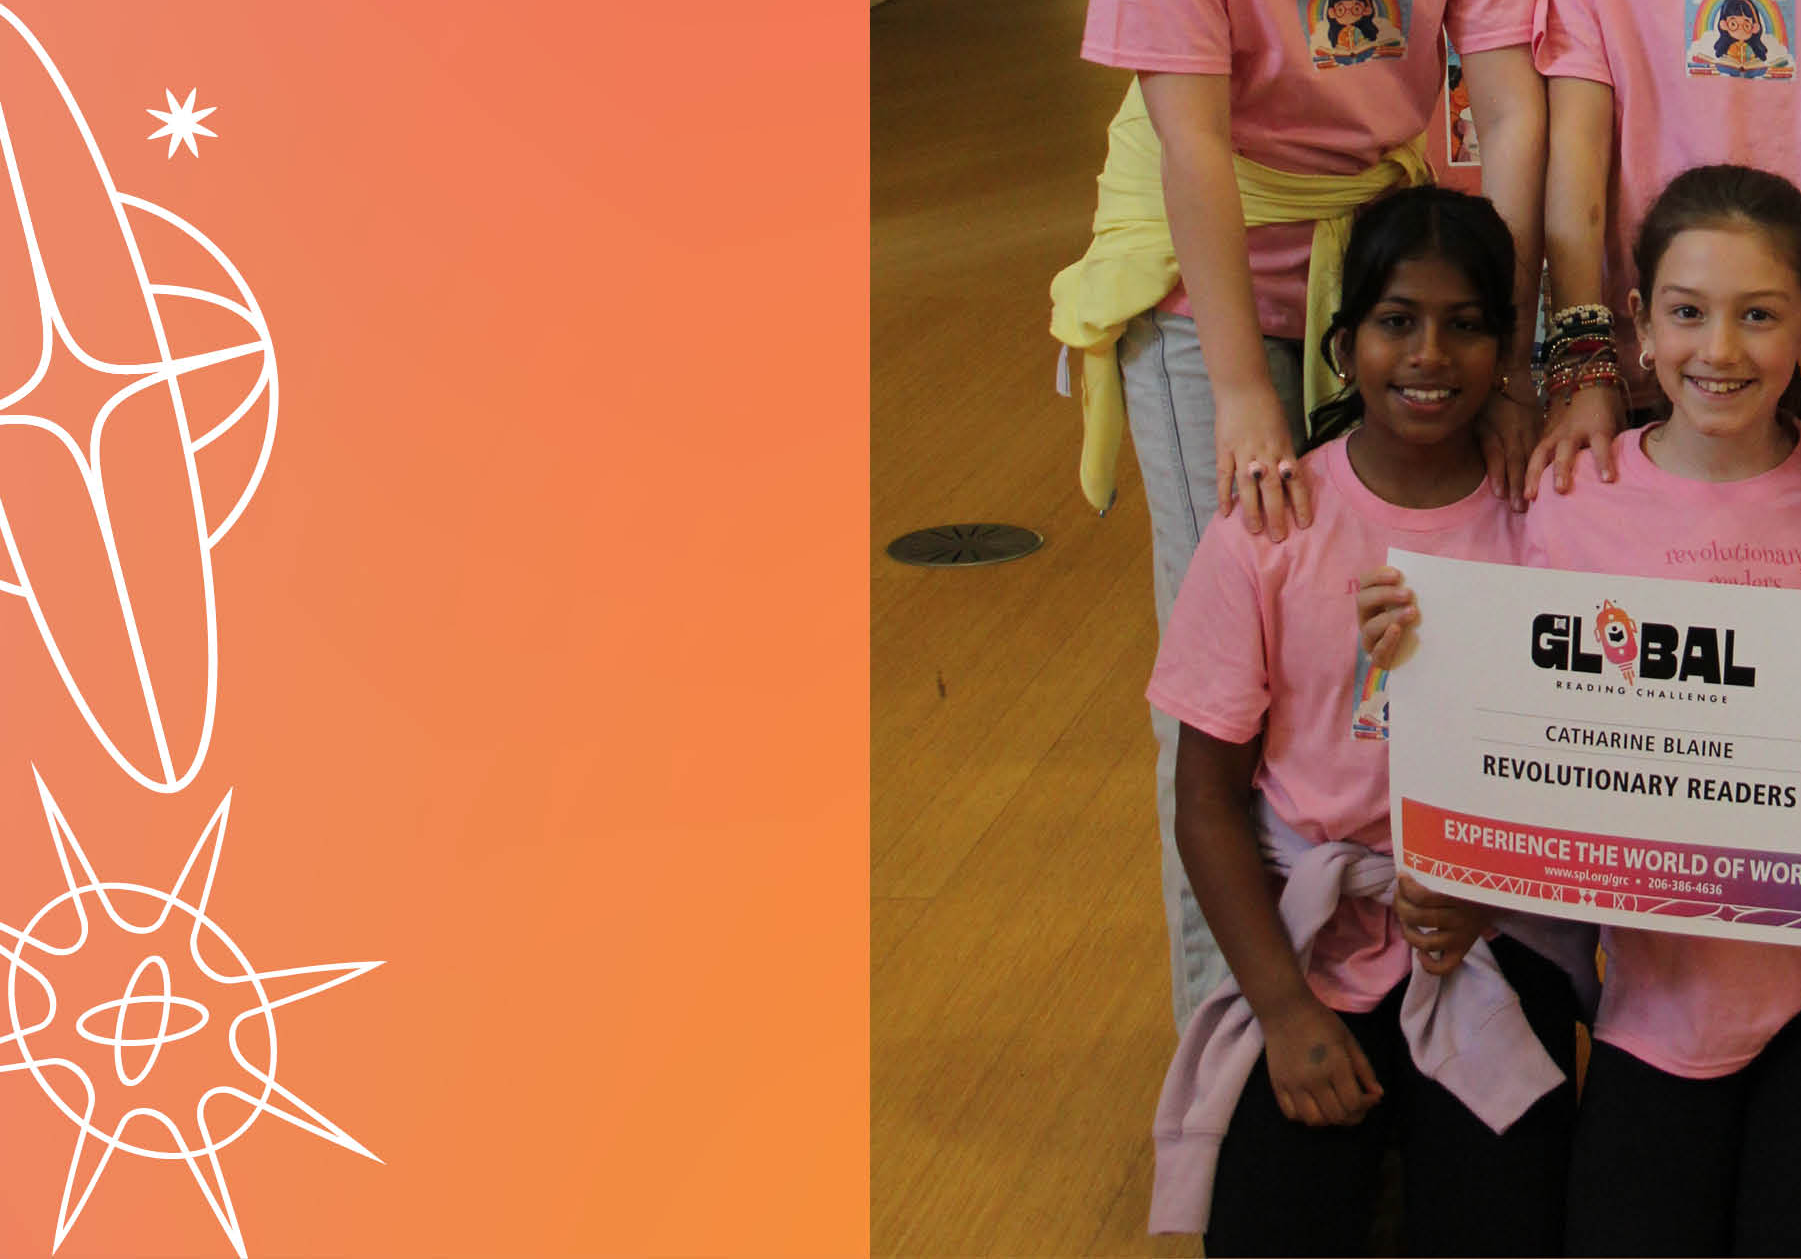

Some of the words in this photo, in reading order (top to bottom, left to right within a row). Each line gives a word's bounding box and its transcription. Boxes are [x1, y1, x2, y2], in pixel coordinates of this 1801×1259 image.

[1555, 680, 1627, 696] READING
[1636, 687, 1729, 705] CHALLENGE
[1545, 725, 1656, 752] CATHARINE
[1663, 736, 1735, 760] BLAINE
[1482, 754, 1679, 798] REVOLUTIONARY
[1687, 777, 1797, 809] READERS
[1444, 818, 1570, 862] EXPERIENCE
[1575, 841, 1618, 868] THE
[1623, 846, 1707, 878] WORLD
[1714, 856, 1745, 881] OF
[1544, 864, 1630, 887] www.spl.org/grc
[1648, 876, 1723, 896] 206-386-4636
